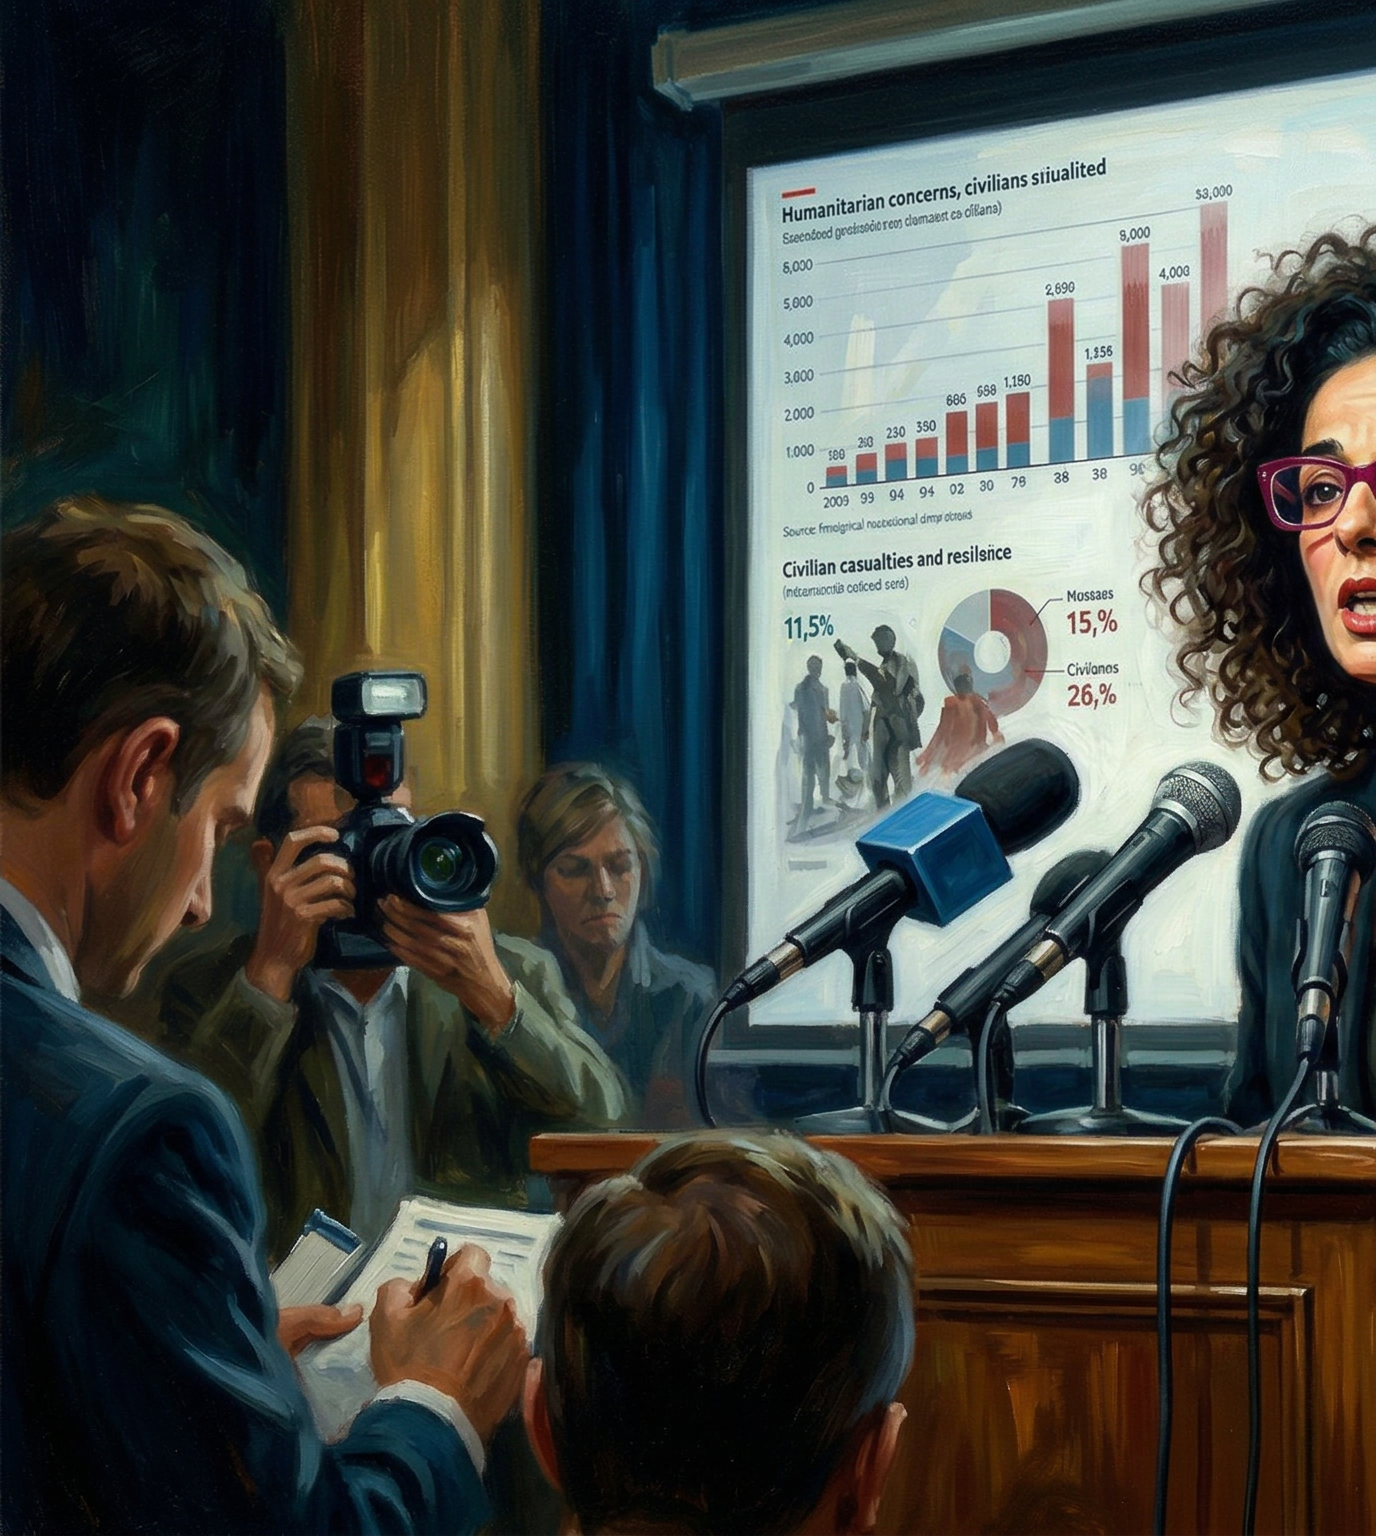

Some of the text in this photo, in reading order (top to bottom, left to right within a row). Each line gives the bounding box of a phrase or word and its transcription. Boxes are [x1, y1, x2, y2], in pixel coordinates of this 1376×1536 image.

[782, 194, 885, 224] Humanitarian
[889, 186, 961, 208] concerns,
[964, 173, 1028, 196] civilians
[783, 331, 814, 347] 4,000
[806, 482, 814, 493] 0
[823, 494, 849, 509] 2009
[889, 489, 905, 501] 94
[919, 486, 935, 498] 94
[949, 483, 965, 495] 02
[1092, 467, 1108, 480] 38
[782, 559, 836, 579] Civilian
[840, 552, 913, 574] casualties
[917, 548, 943, 567] and
[784, 614, 834, 643] 11,5%
[1067, 608, 1118, 638] 15,%
[1067, 682, 1117, 710] 26,%
